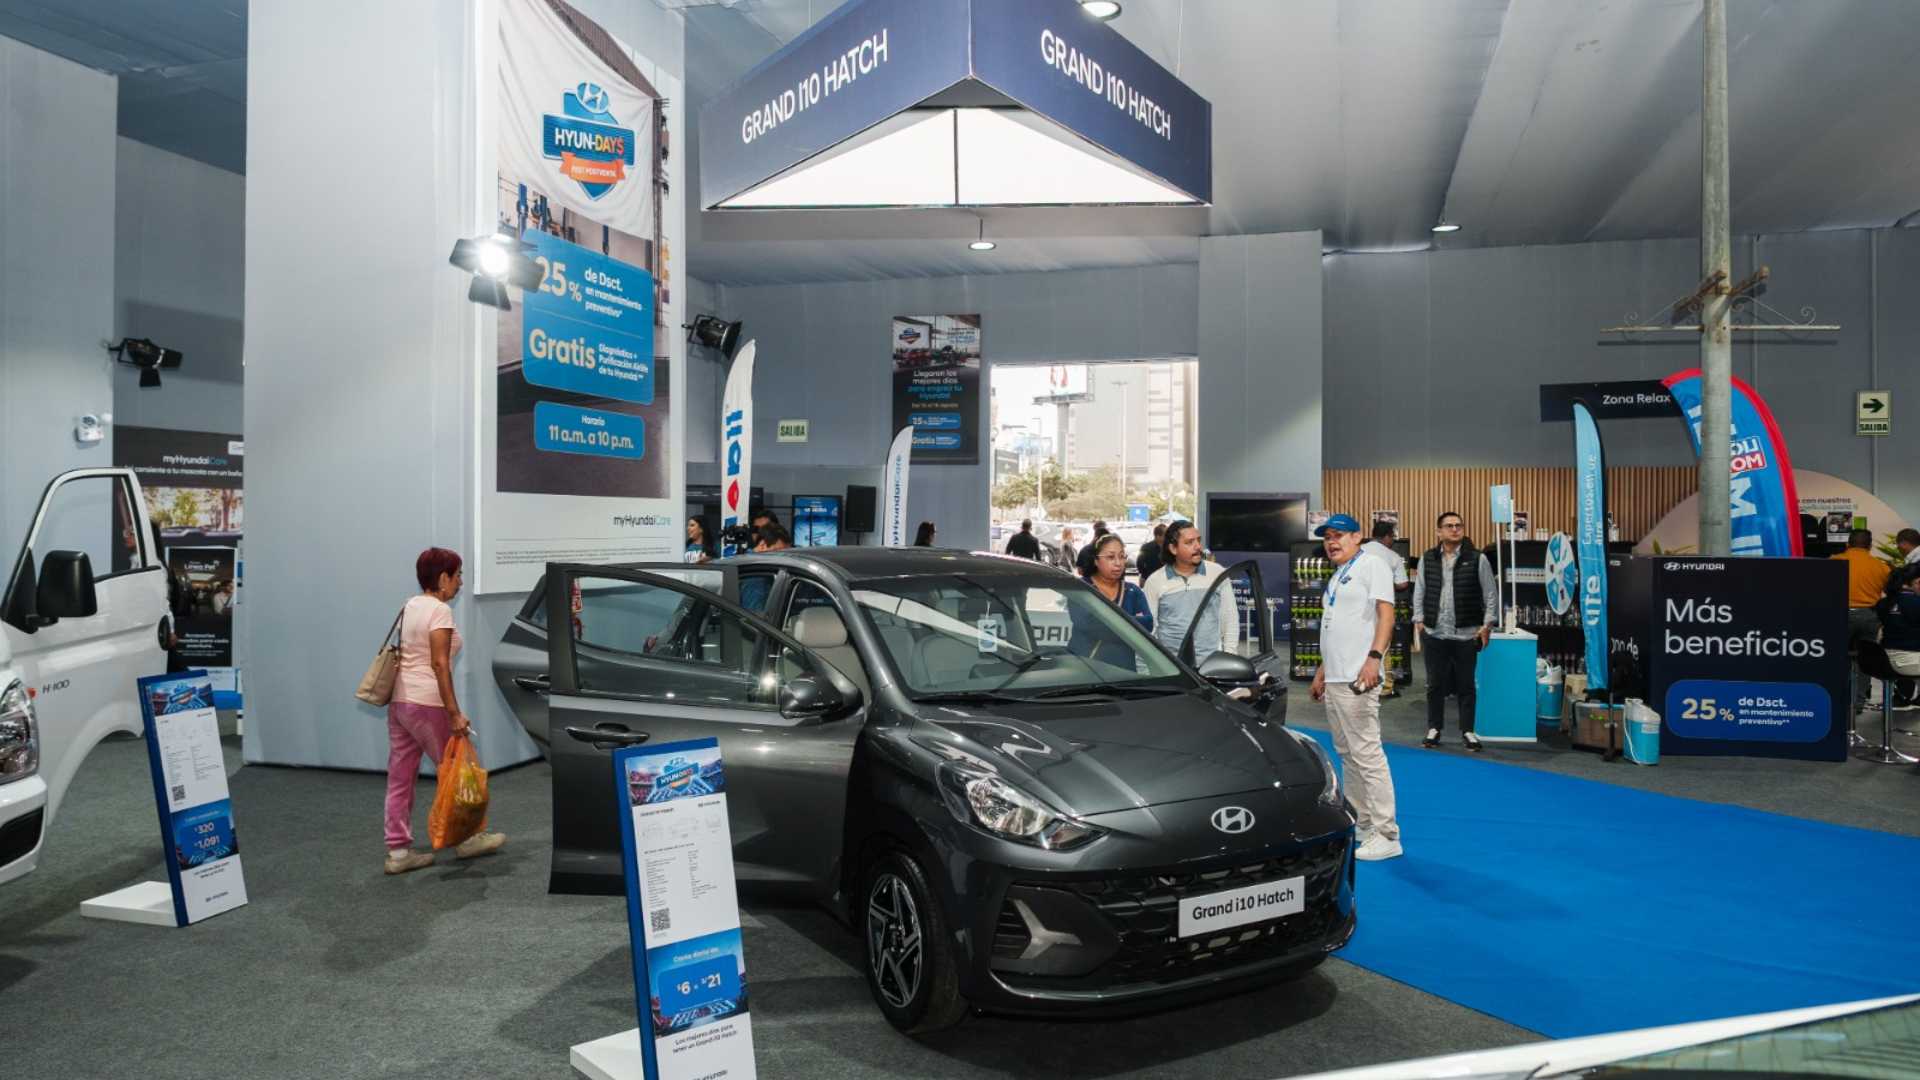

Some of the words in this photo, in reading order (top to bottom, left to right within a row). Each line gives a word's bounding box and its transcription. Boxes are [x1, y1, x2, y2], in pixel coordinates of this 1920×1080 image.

[742, 89, 796, 144] GRAND
[799, 72, 820, 112] I10
[824, 28, 888, 97] HATCH
[1041, 29, 1104, 95] GRAND
[1106, 71, 1126, 110] I10
[1128, 86, 1171, 141] HATCH
[555, 127, 624, 155] HYUN-DAYS
[536, 255, 567, 297] 25
[568, 281, 582, 301] %
[584, 267, 597, 283] de
[599, 272, 623, 292] Dsct.
[595, 288, 642, 311] mantenimiento
[529, 328, 596, 369] Gratis
[1602, 394, 1634, 405] Zona
[1636, 392, 1671, 403] Relax
[582, 415, 605, 426] Horario
[780, 424, 806, 437] SALIDA
[1859, 423, 1887, 431] SALIDA
[548, 424, 558, 440] 11
[561, 429, 586, 444] a.m.
[588, 432, 596, 445] a
[598, 430, 609, 446] 10
[611, 436, 634, 450] p.m.
[1682, 562, 1725, 570] HYUNDAI
[1665, 596, 1733, 624] Más
[1664, 629, 1825, 658] beneficios
[1681, 698, 1717, 720] 25
[1719, 708, 1735, 721] %
[1738, 697, 1754, 707] de
[1756, 697, 1788, 708] Dsct.
[1739, 708, 1750, 716] en
[1751, 708, 1815, 718] mantenimiento
[1192, 897, 1233, 920] Grand
[1235, 896, 1255, 912] i10
[1257, 888, 1294, 907] Hatch
